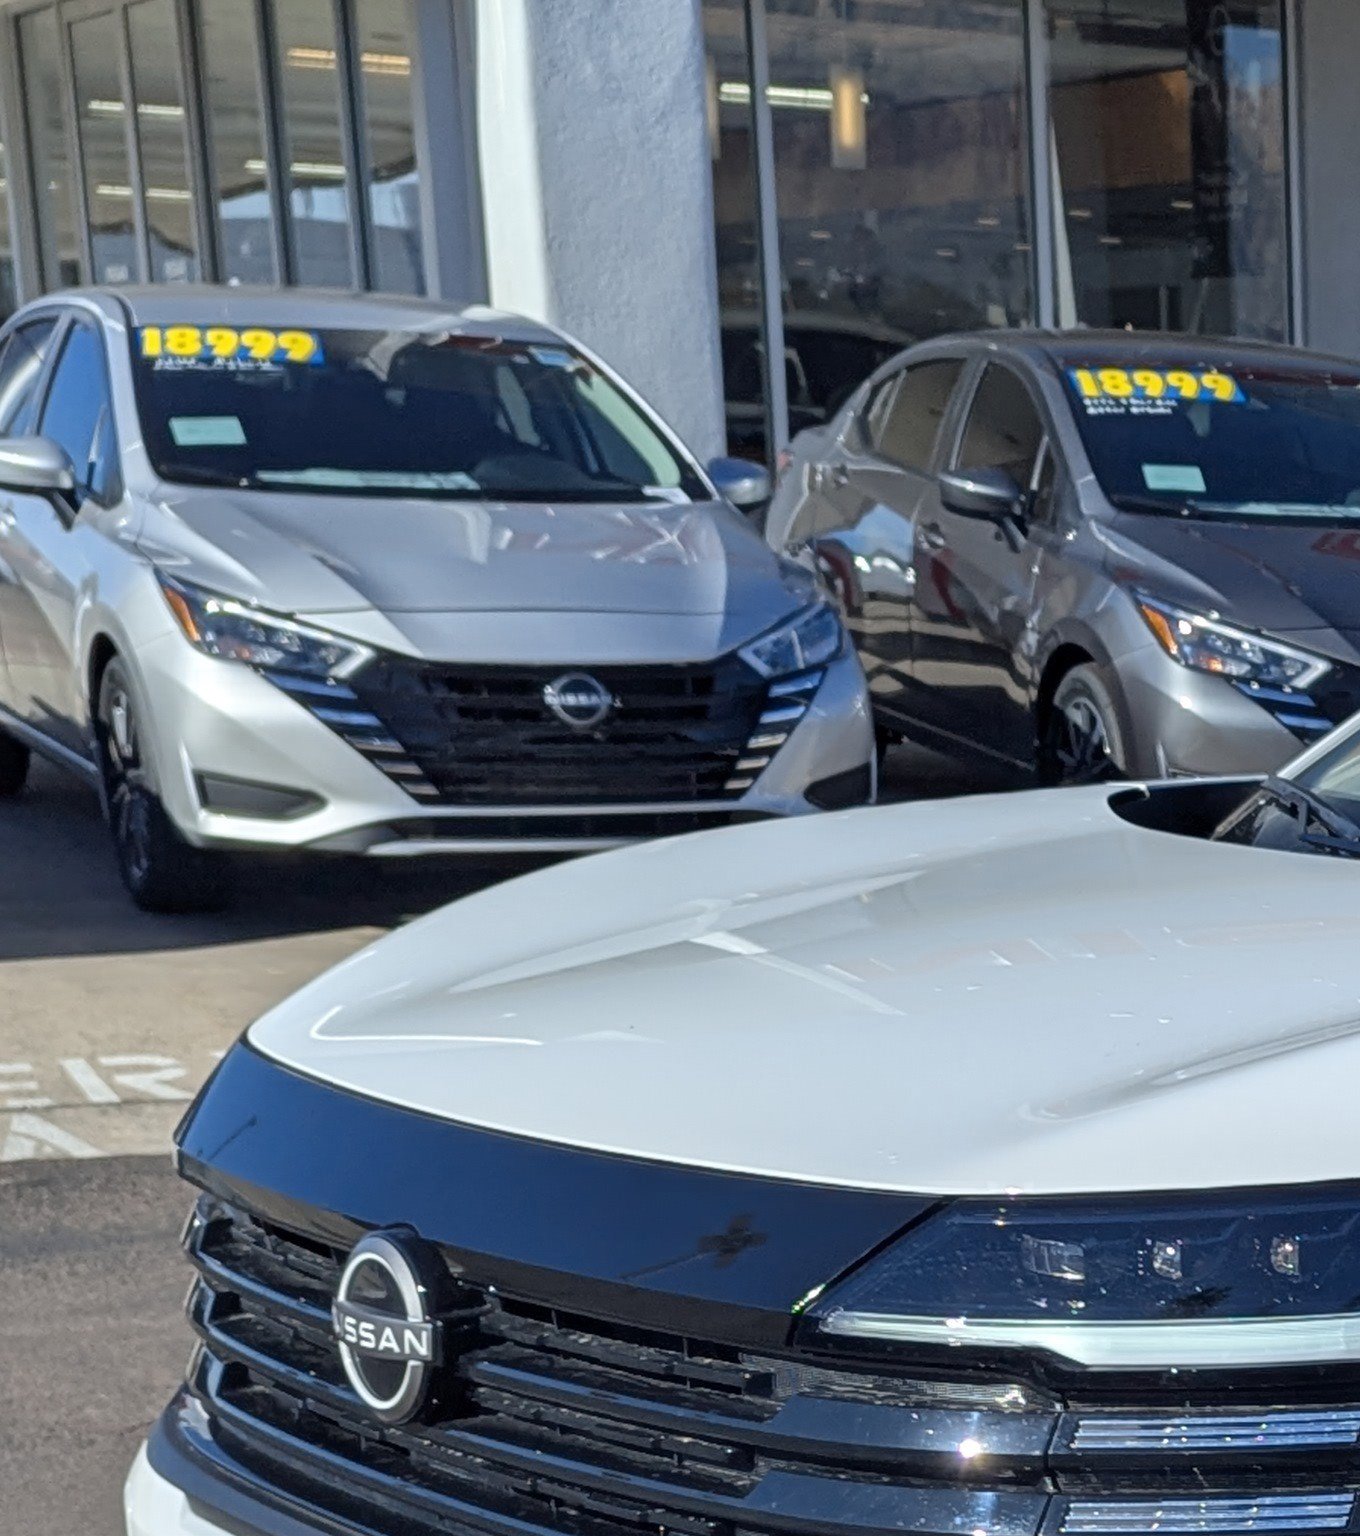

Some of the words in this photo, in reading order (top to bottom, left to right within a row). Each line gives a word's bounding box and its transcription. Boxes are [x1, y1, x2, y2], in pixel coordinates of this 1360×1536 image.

[141, 325, 315, 362] 18999
[1076, 367, 1236, 402] 18999
[331, 1303, 429, 1356] ISSAN
